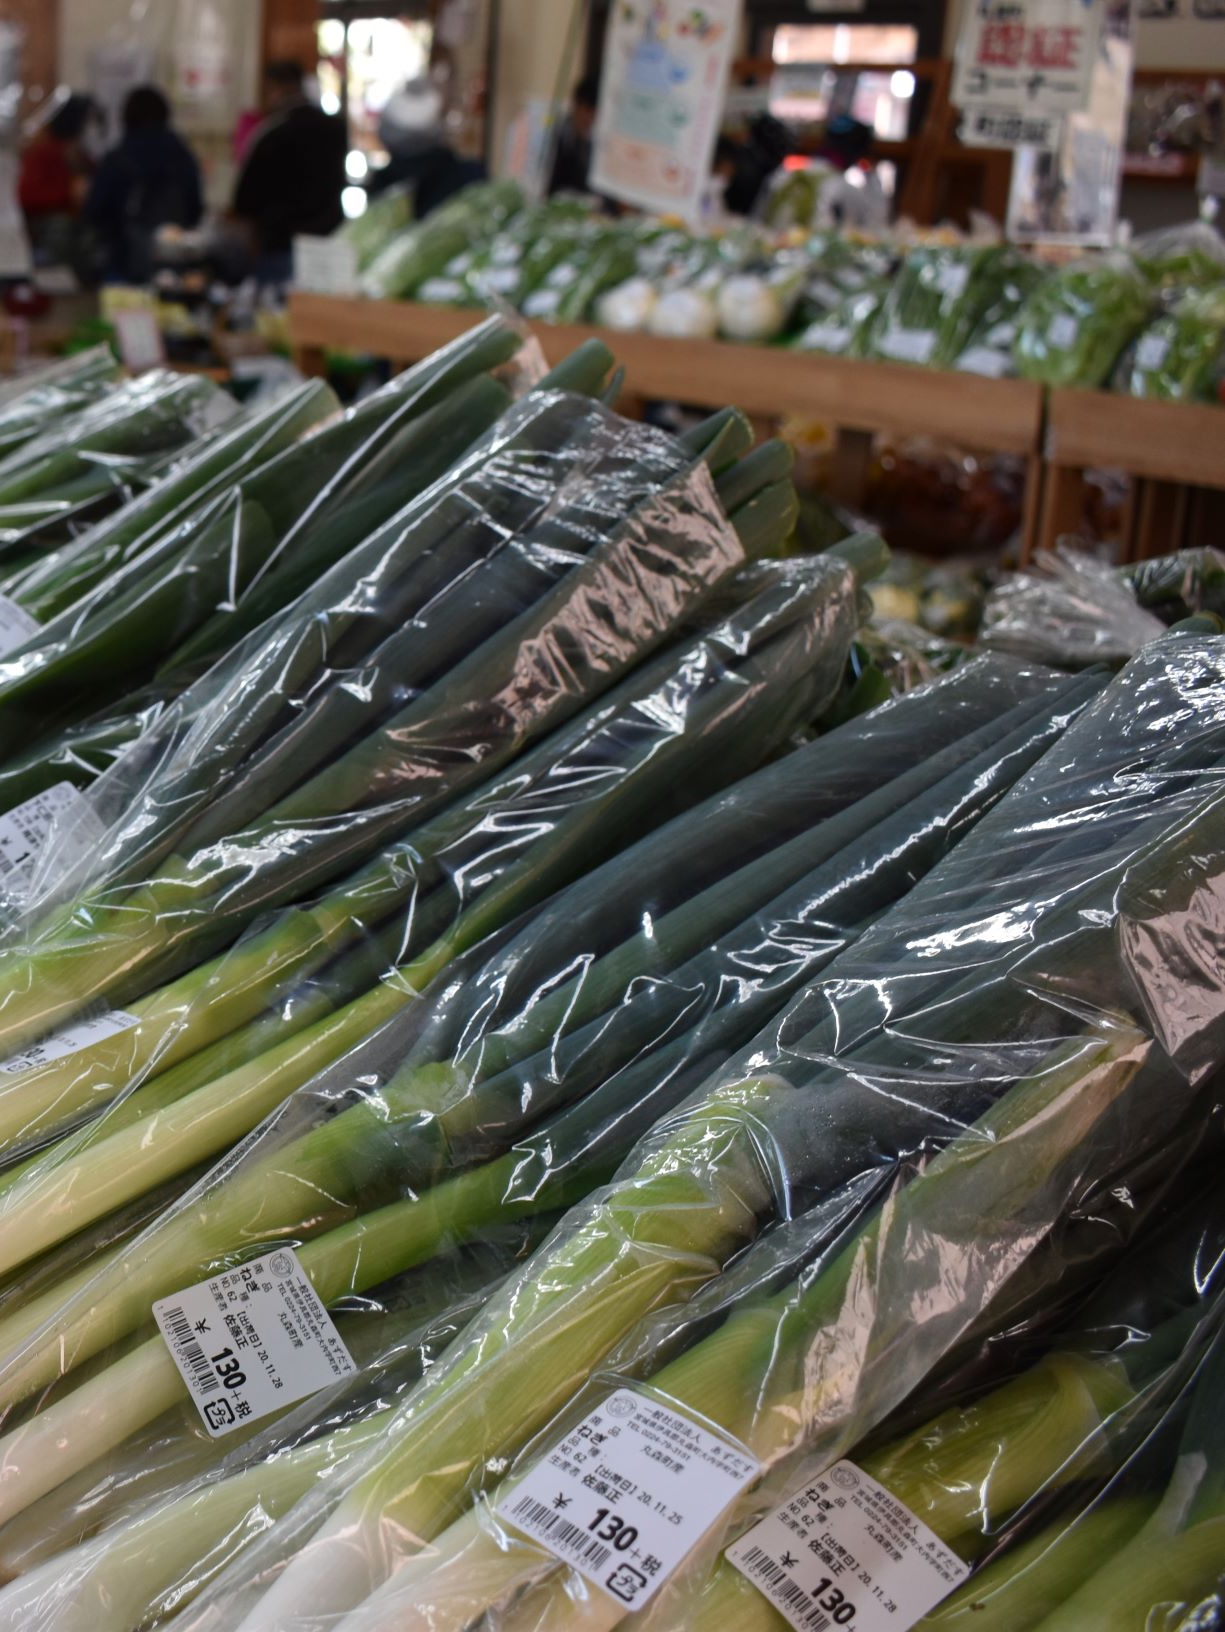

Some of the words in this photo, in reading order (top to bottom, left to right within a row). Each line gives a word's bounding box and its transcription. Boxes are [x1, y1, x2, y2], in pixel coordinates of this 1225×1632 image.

[239, 1266, 260, 1293] ねぎ
[276, 1281, 287, 1296] TEL
[210, 1346, 247, 1389] 130
[576, 1424, 608, 1446] ねぎ
[804, 1487, 834, 1512] ねぎ
[587, 1508, 638, 1551] 130
[810, 1577, 856, 1625] 130
